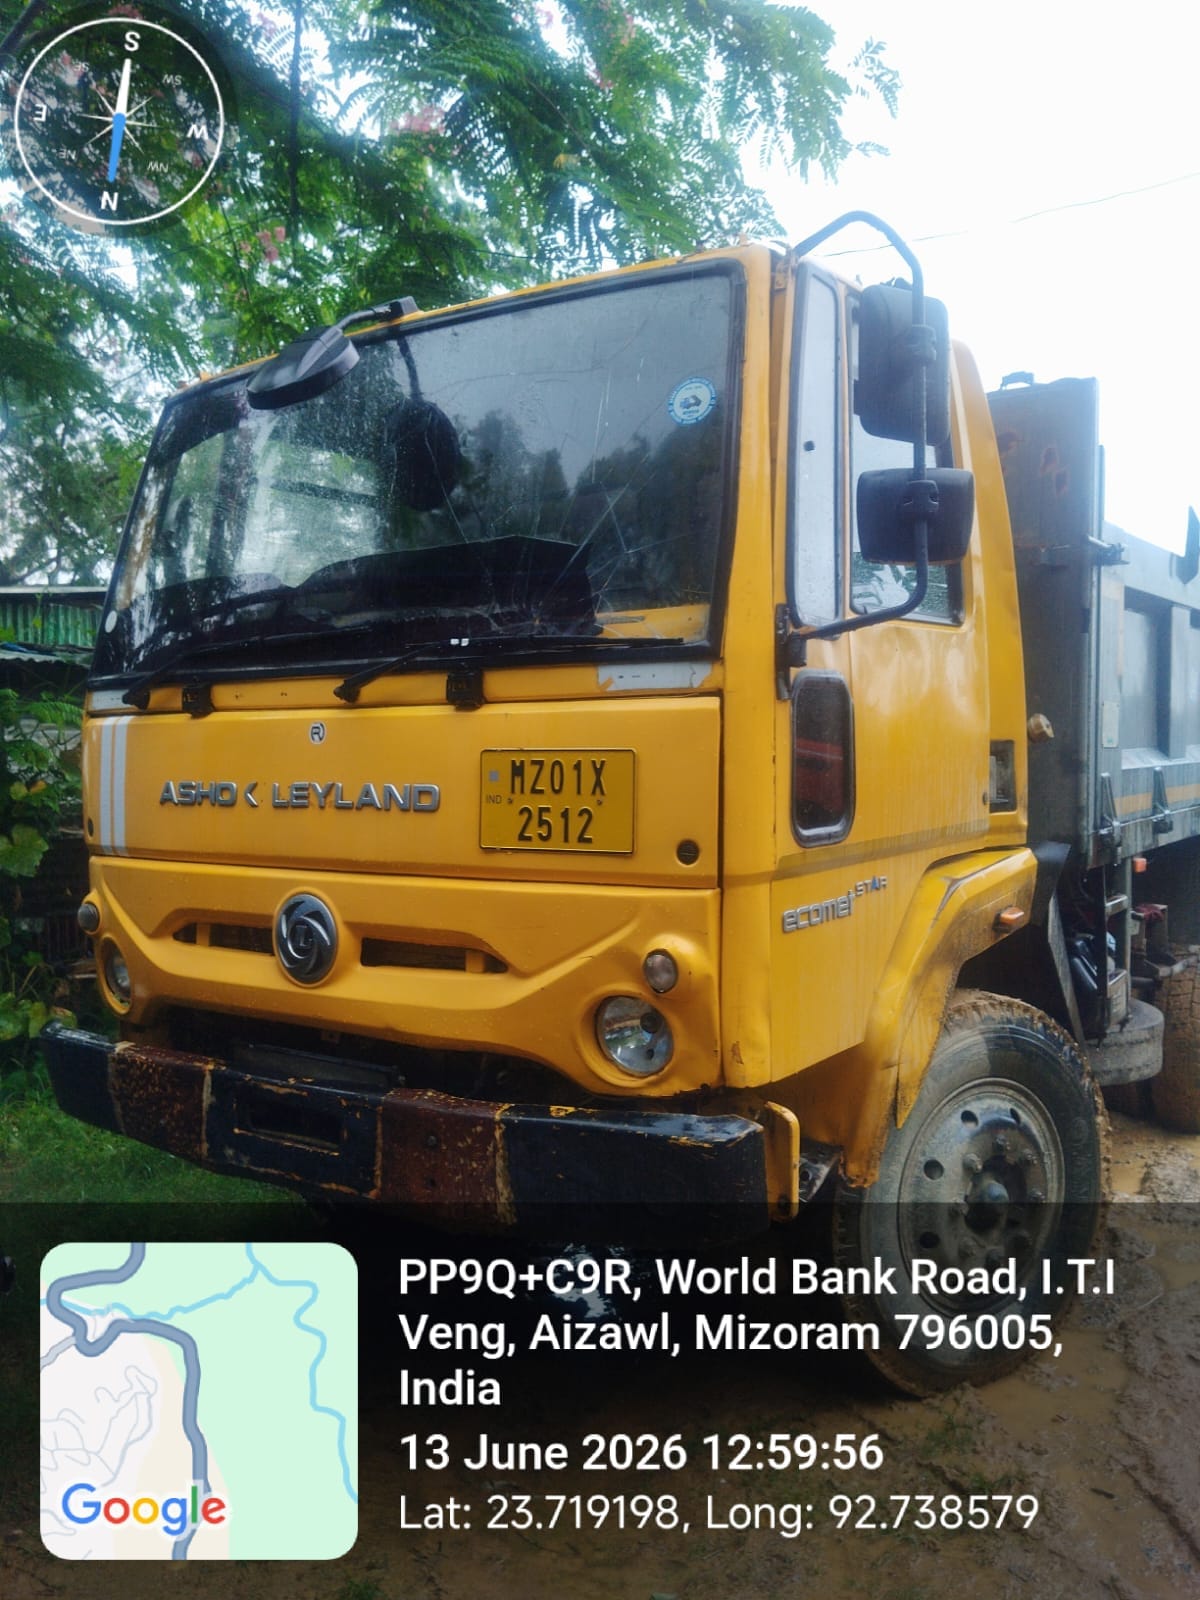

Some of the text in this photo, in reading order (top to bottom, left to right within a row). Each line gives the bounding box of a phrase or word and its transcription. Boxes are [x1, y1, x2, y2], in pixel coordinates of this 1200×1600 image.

[510, 759, 607, 796] MZ01X
[272, 781, 441, 812] LEYLAND
[486, 794, 503, 805] IND
[517, 805, 594, 843] 2512
